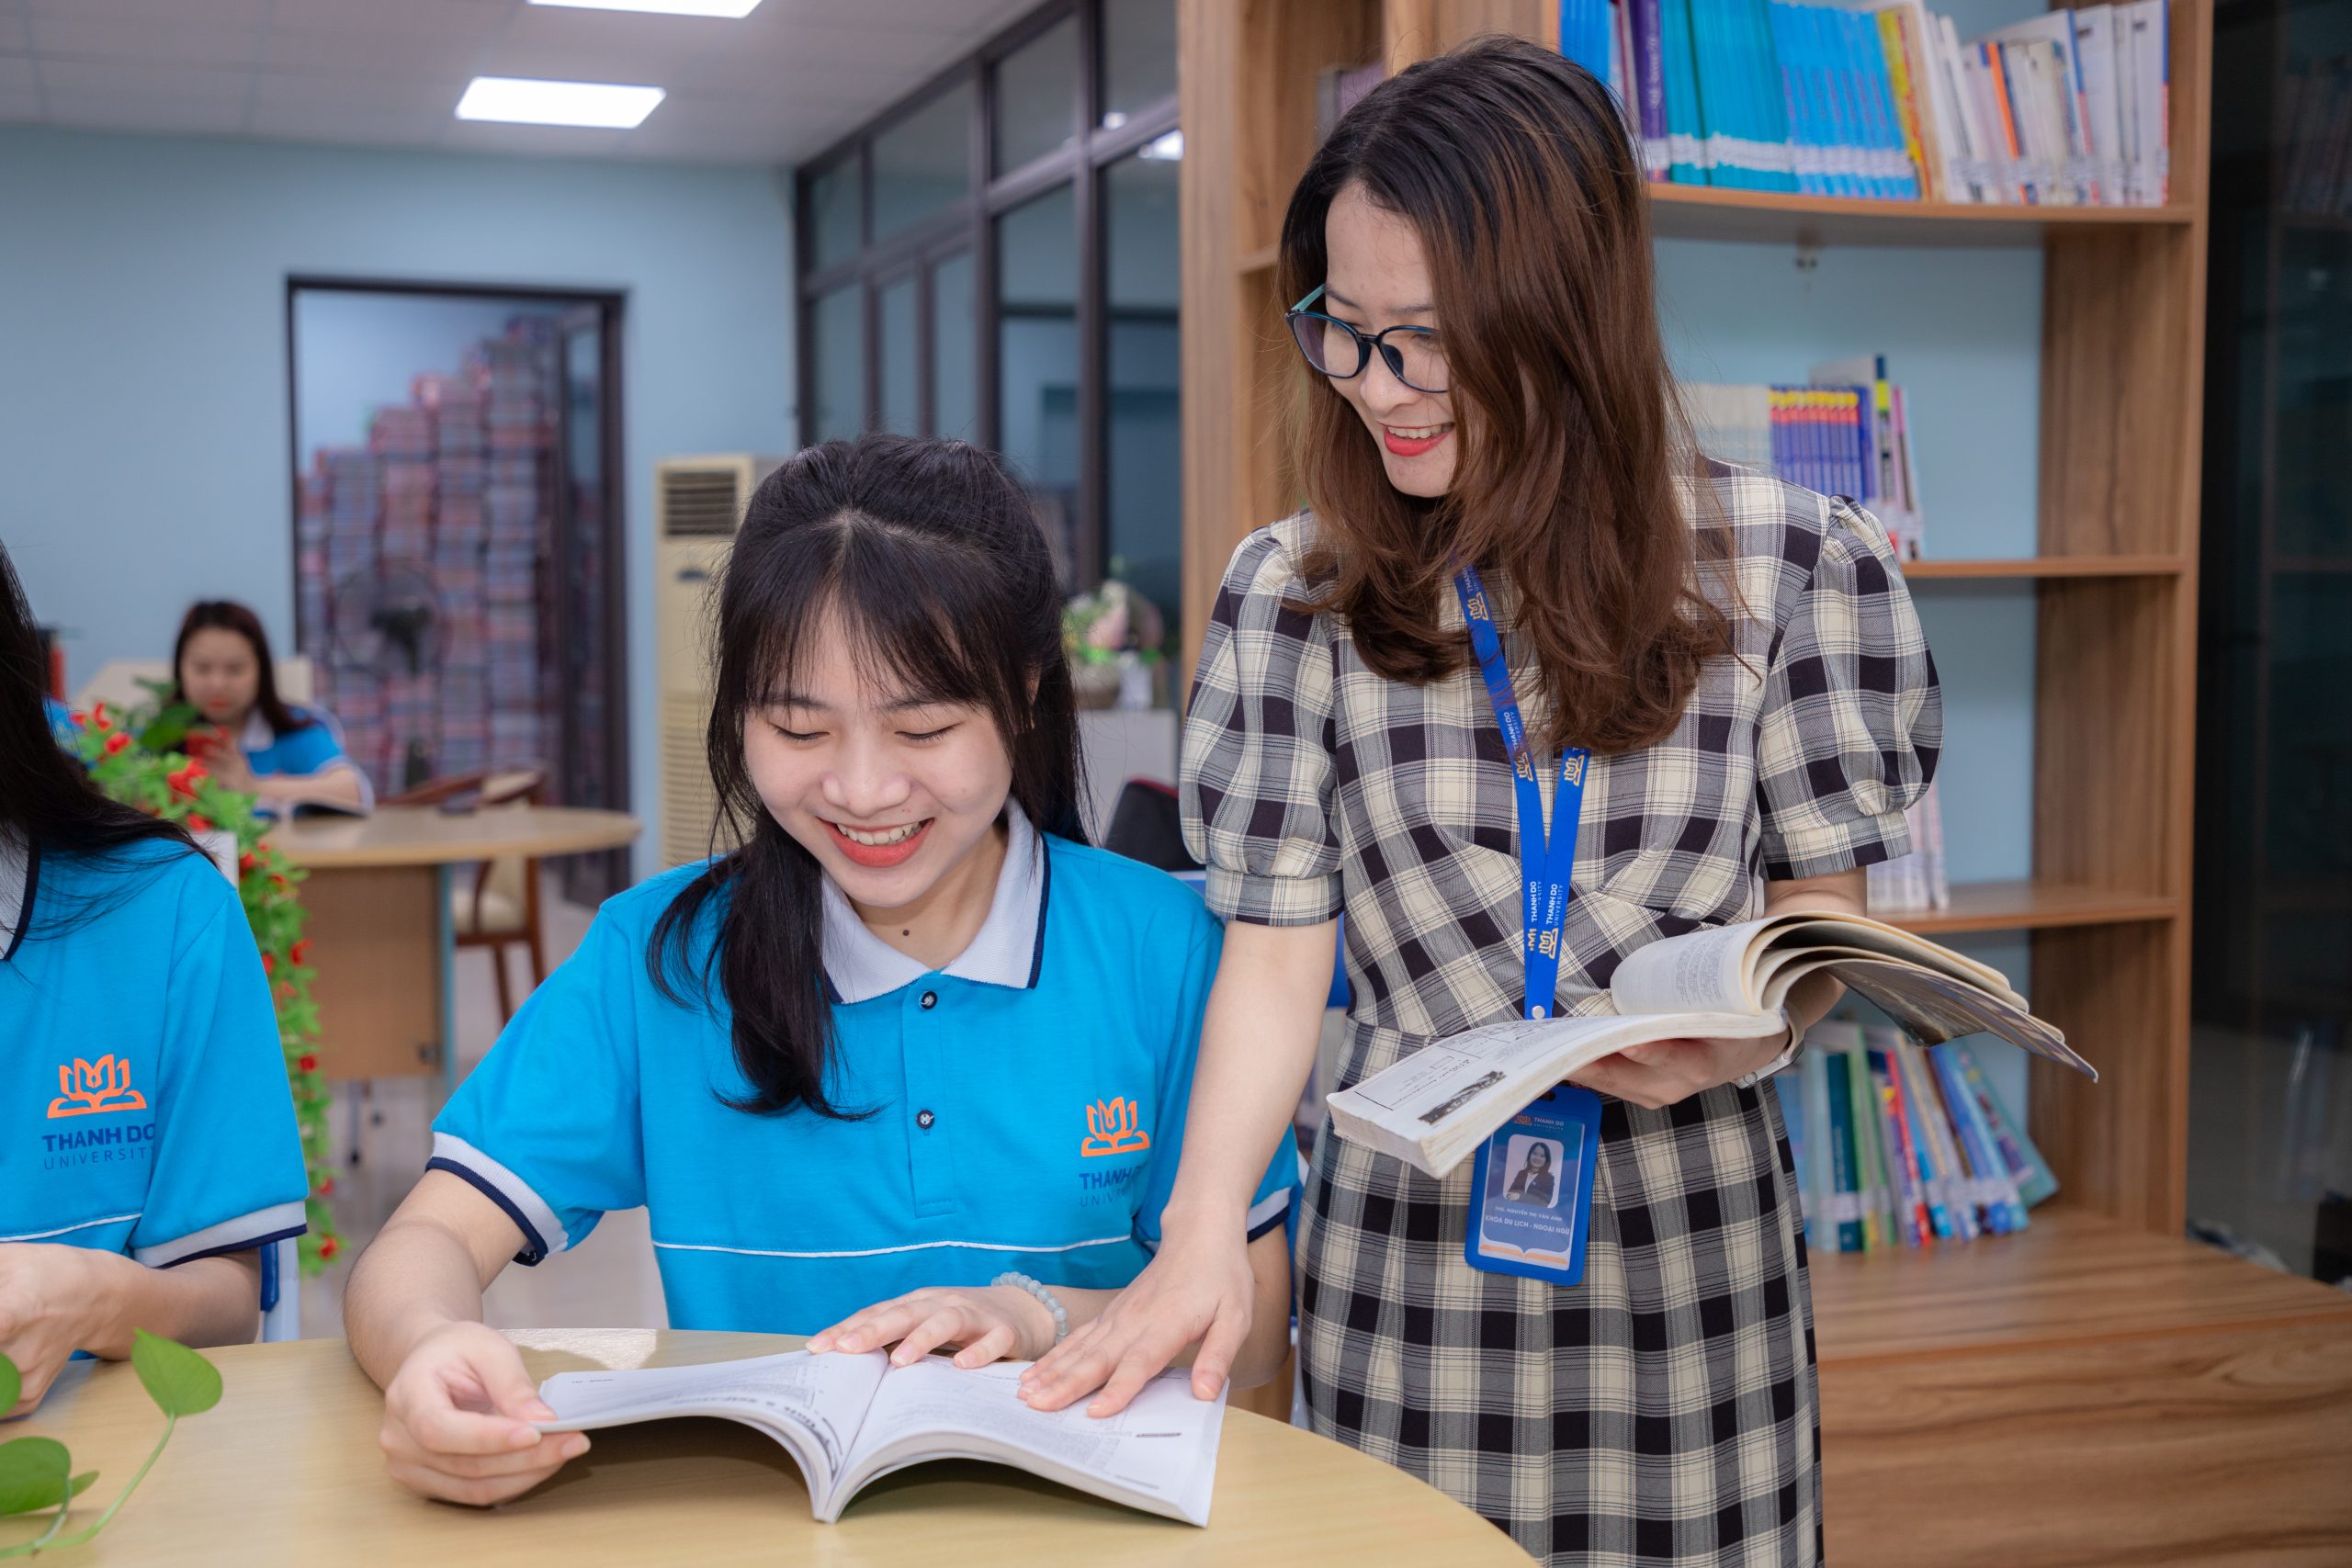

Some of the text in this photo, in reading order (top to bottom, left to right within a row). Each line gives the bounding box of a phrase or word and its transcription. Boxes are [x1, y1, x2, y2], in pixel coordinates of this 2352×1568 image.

[1503, 712, 1512, 723] DO
[1530, 881, 1537, 893] DO
[1546, 884, 1558, 925] THANH DO
[1553, 885, 1564, 926] UNIVERSITY
[41, 1126, 122, 1152] THANH
[44, 1146, 153, 1169] UNIVERSIT
[1079, 1168, 1133, 1190] THANH
[1485, 1214, 1503, 1224] KHOA
